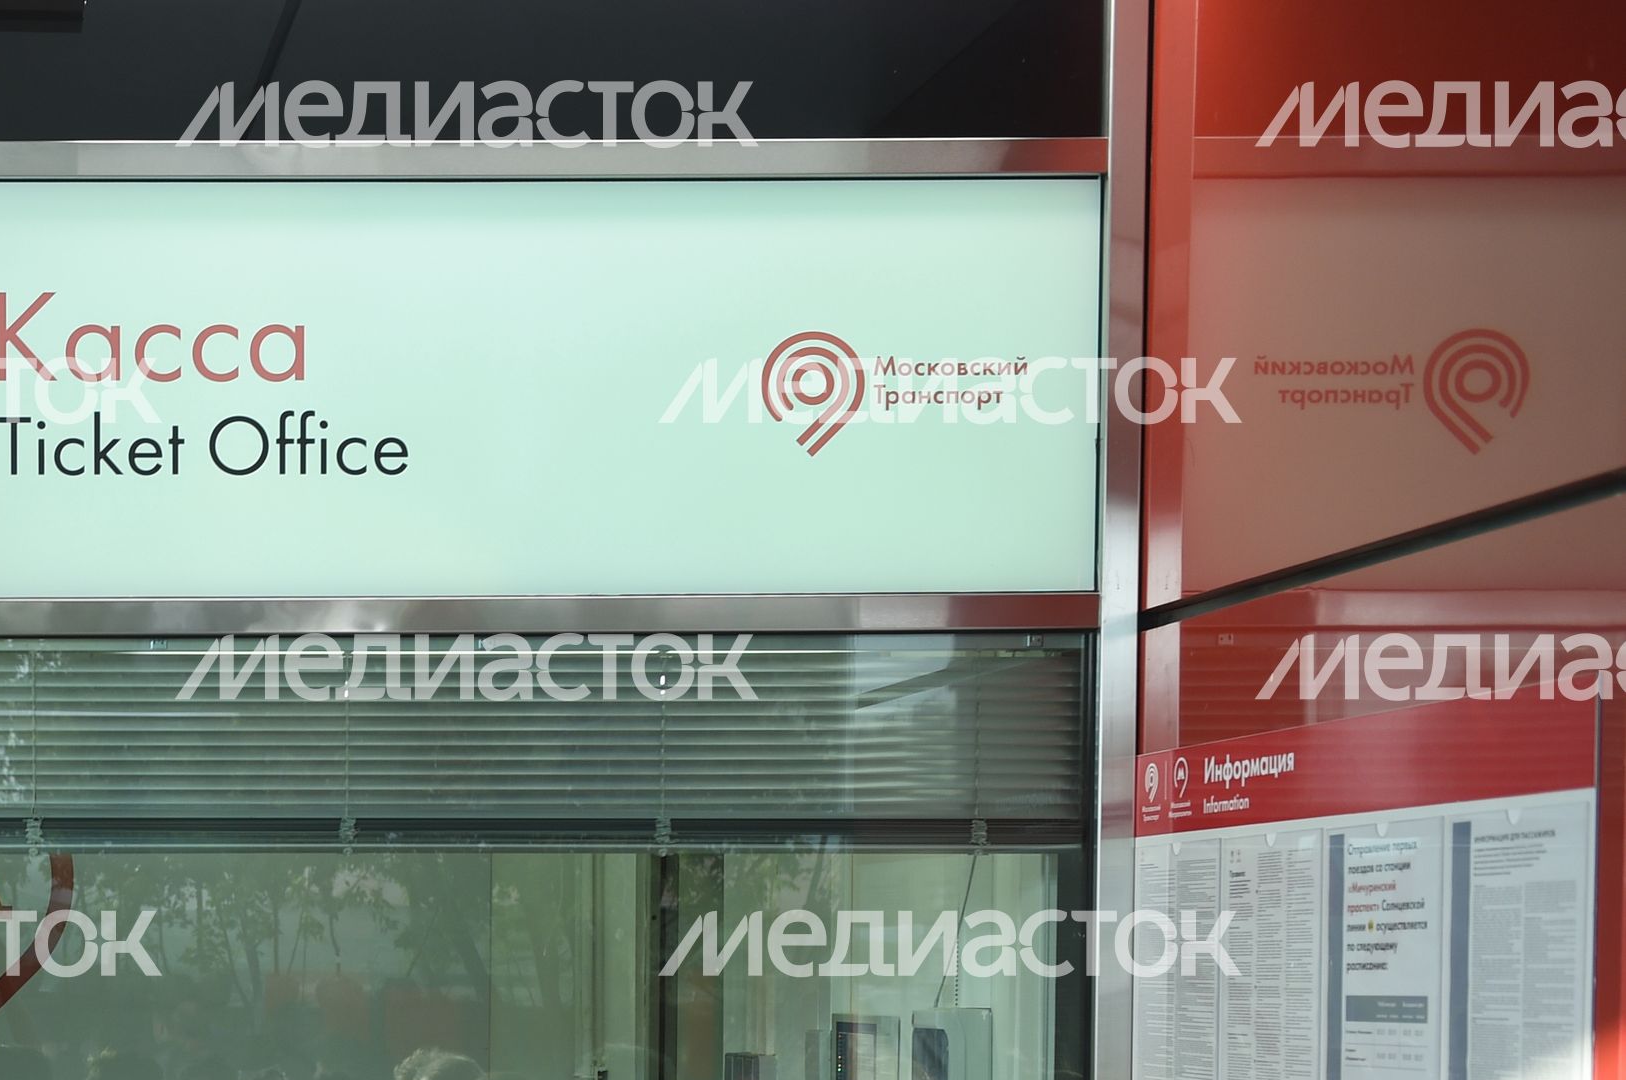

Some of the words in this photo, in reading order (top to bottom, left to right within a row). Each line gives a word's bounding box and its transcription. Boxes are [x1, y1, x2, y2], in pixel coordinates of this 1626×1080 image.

[874, 355, 1029, 377] Московский
[874, 384, 1004, 411] Транспорт
[208, 410, 410, 477] Office
[1203, 752, 1295, 789] Информация
[1203, 793, 1250, 815] Information
